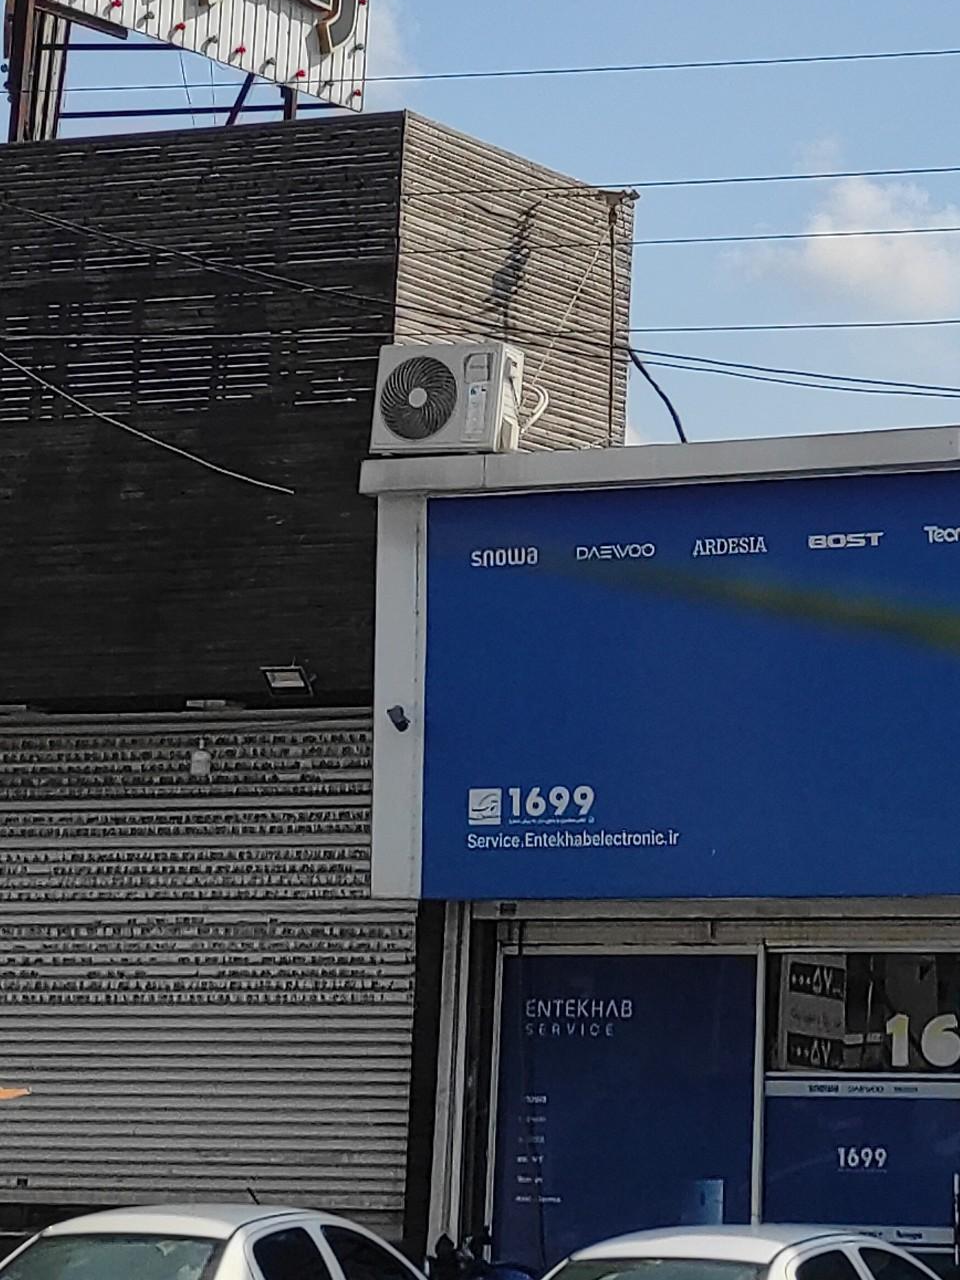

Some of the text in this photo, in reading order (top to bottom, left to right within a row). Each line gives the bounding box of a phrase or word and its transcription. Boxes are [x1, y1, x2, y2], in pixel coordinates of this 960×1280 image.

[692, 536, 768, 557] ARDESIA
[808, 532, 884, 550] BOST
[470, 546, 538, 567] snowa
[576, 543, 656, 561] DAEWOO
[508, 786, 595, 817] 1699
[467, 829, 679, 849] Service.Entekhabelectronic.ir
[525, 999, 633, 1018] ENTEKHAB
[525, 1023, 614, 1037] SERVICE
[837, 1147, 888, 1168] 1699
